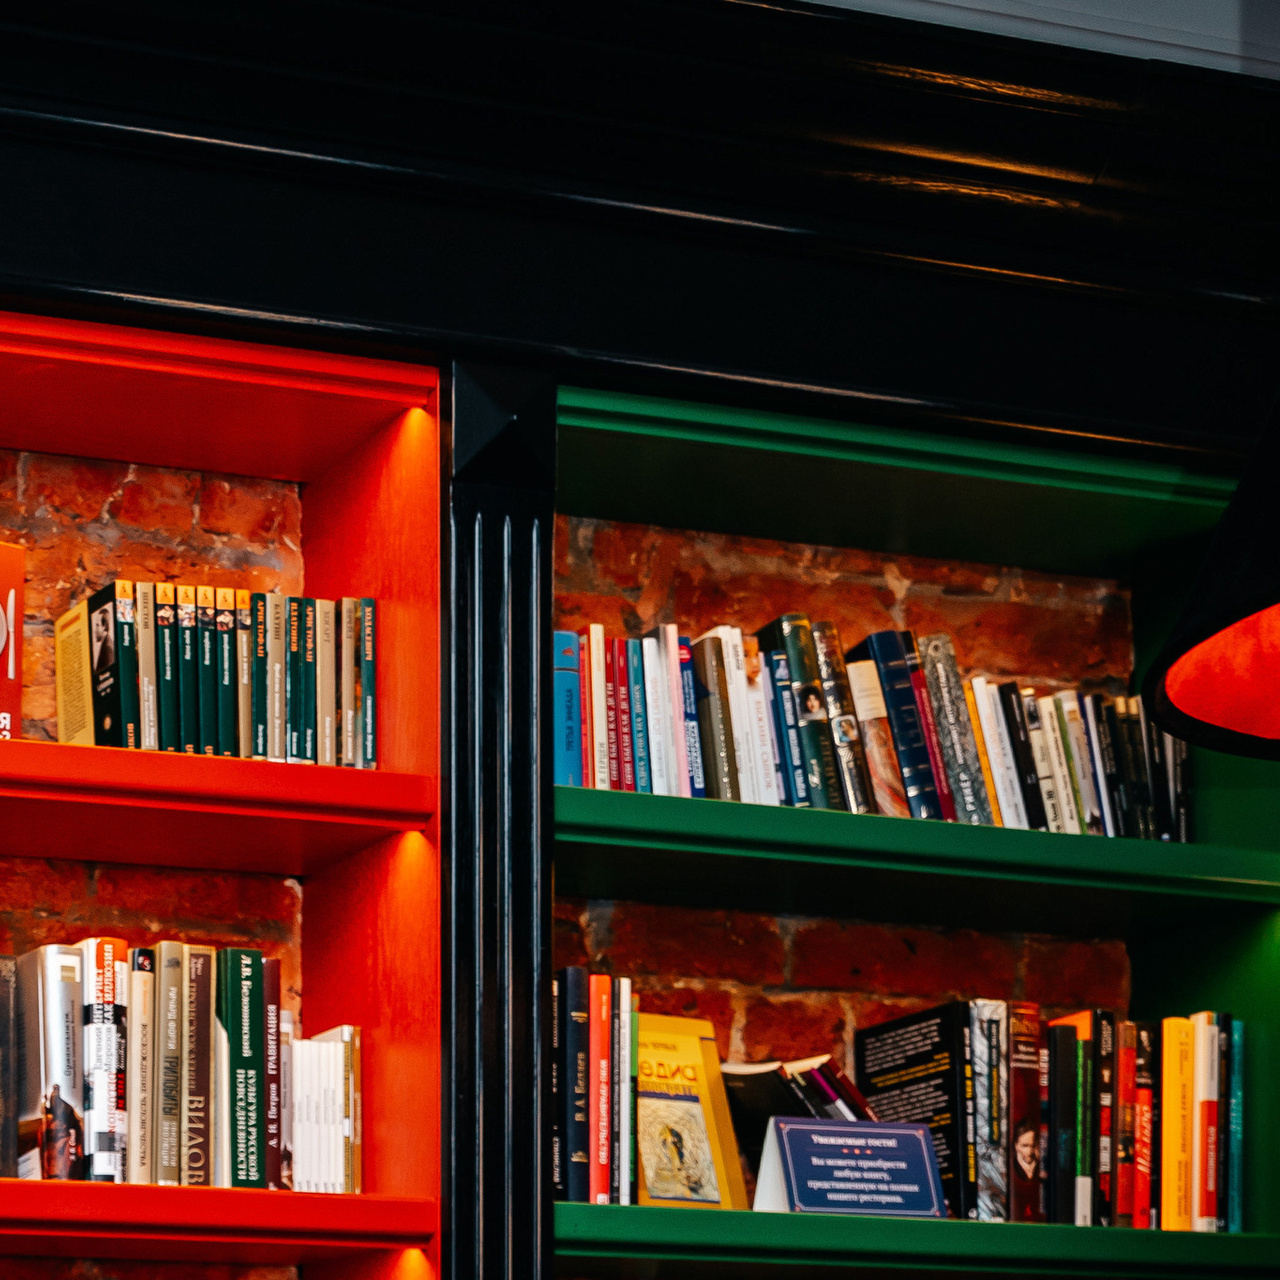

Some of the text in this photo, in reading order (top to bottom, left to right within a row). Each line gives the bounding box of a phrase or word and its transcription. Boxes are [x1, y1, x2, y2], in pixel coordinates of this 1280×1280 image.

[103, 943, 114, 1024] КАК ИЛЛЮЗИЯ
[267, 1003, 278, 1074] ГРАВИТАЦИЯ
[161, 1055, 178, 1116] ТРИЛОБИТЫ
[185, 982, 205, 1187] ПРОИСХОЖДЕНИЕ ВИДОВ
[234, 1069, 246, 1181] ПОВСЕДНЕВНОСТИ
[246, 1069, 258, 1181] КУЛЬТУРА РУССКОЙ
[268, 1081, 279, 1118] Петров
